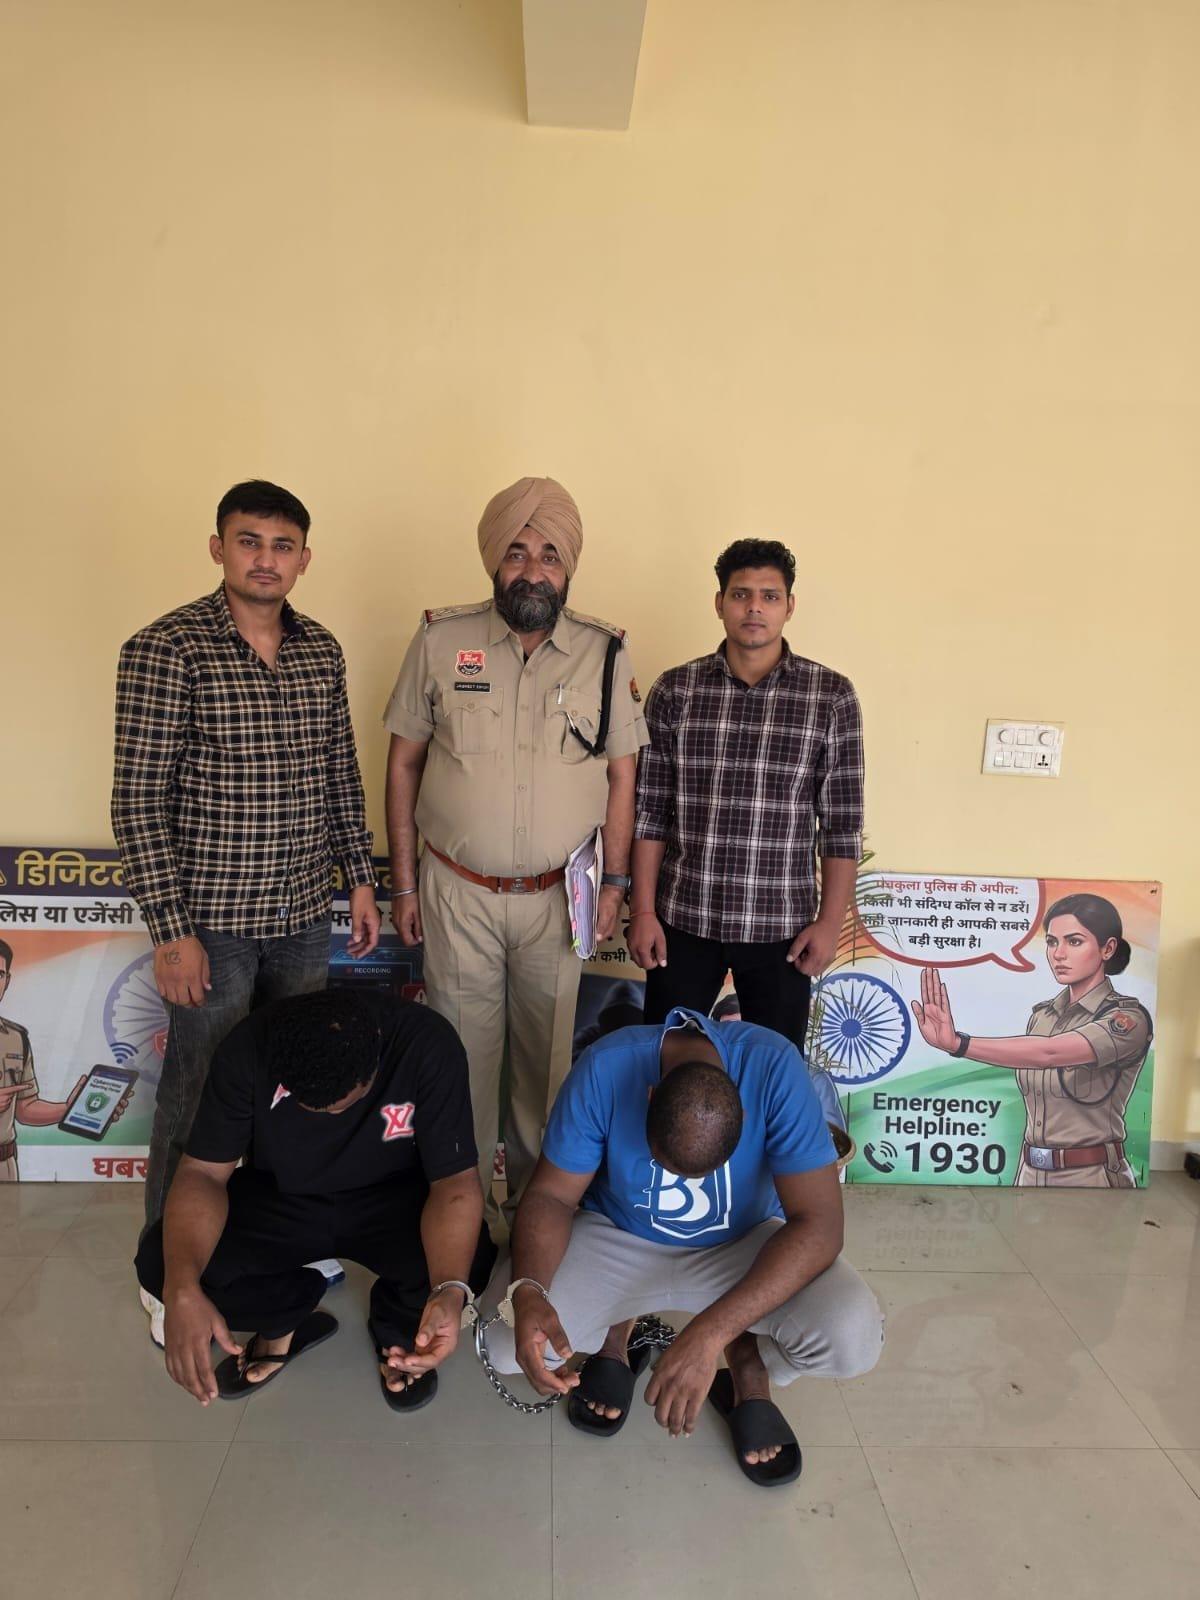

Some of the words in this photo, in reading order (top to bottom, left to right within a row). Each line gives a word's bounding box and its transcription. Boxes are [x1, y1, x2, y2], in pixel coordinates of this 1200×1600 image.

[876, 880, 920, 893] पचकुला
[924, 879, 957, 894] पुलिस
[960, 880, 977, 893] की
[980, 881, 1018, 894] अपील:
[43, 907, 68, 923] या
[73, 902, 134, 924] एजेंसी
[897, 896, 912, 908] भी
[915, 897, 952, 910] संदिग्ध
[955, 898, 981, 911] कॉल
[984, 899, 995, 911] से
[998, 903, 1007, 912] न
[1009, 901, 1029, 913] डरें।
[888, 915, 938, 928] जानकारी
[941, 916, 954, 929] ही
[957, 917, 997, 930] आपकी
[1000, 919, 1030, 931] सबसे
[908, 933, 930, 947] बड़ी
[933, 935, 965, 949] सुरक्षा
[968, 935, 981, 948] है।
[600, 948, 627, 962] कभी
[873, 1092, 1001, 1118] Emergency
[885, 1116, 987, 1139] Helpline:
[92, 1157, 149, 1178] घबर
[905, 1142, 1006, 1175] 1930
